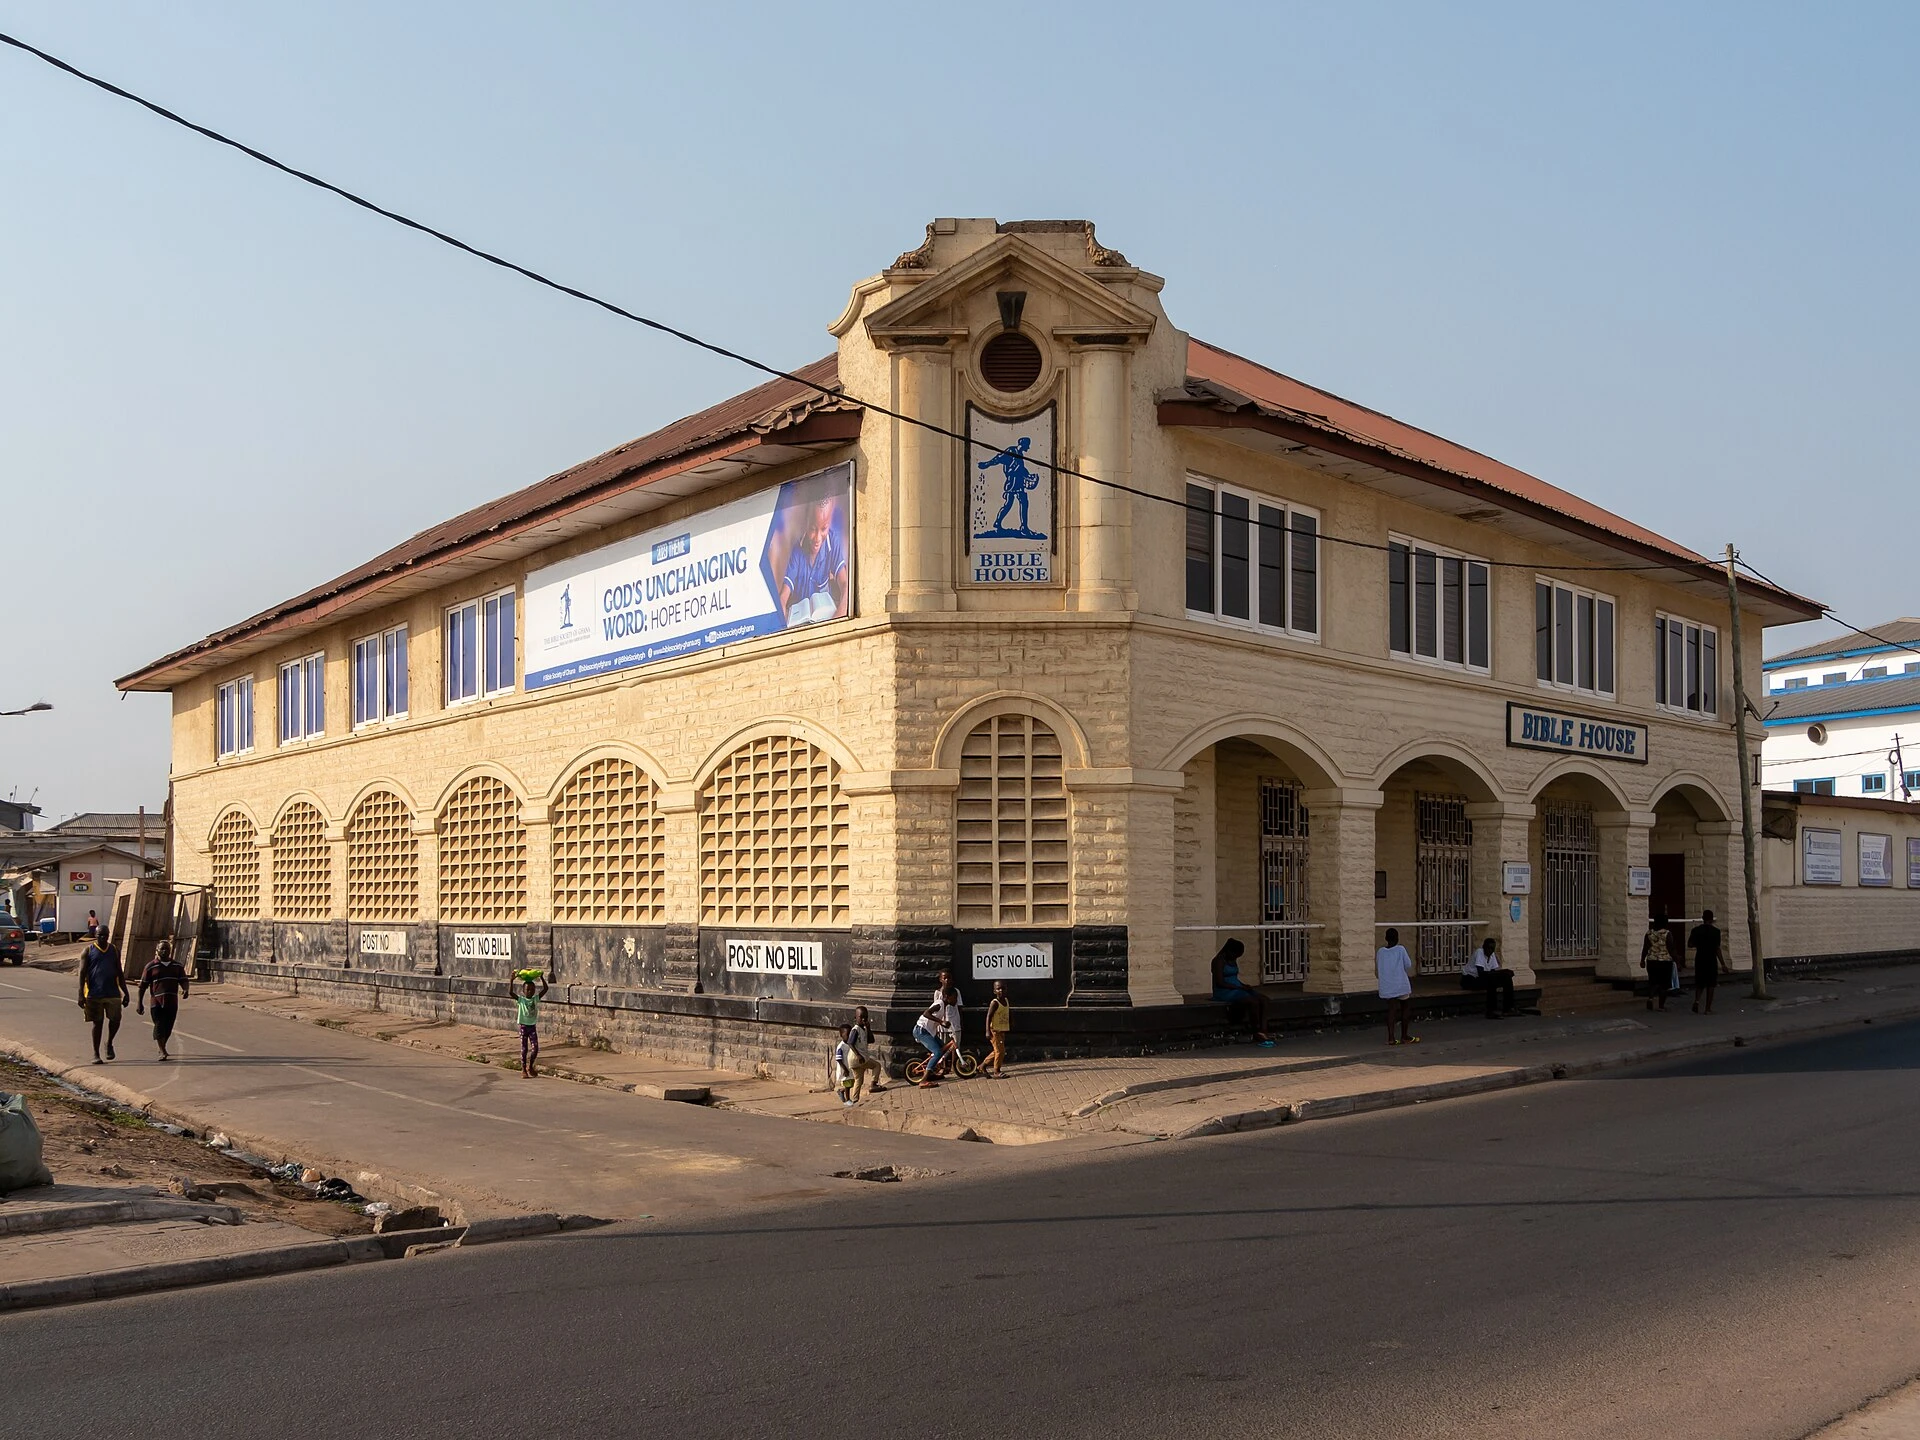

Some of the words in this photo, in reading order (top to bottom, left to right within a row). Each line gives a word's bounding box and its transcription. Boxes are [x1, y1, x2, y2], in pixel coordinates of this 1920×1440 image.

[980, 553, 1042, 567] BIBLE
[604, 580, 642, 613] GOD'S
[646, 547, 747, 601] UNCHANGING
[974, 568, 1048, 581] HOUSE
[603, 609, 648, 641] WORD:
[651, 603, 681, 630] HOPE
[684, 596, 706, 620] FOR
[710, 588, 731, 613] ALL
[1522, 712, 1574, 746] BIBLE
[1579, 722, 1636, 754] HOUSE
[362, 934, 379, 950] POST
[380, 934, 389, 951] NO
[456, 937, 475, 955] POST
[478, 938, 490, 955] NO
[491, 938, 510, 956] BILL
[729, 945, 761, 968] POST
[766, 946, 785, 970] NO
[787, 946, 818, 970] BILL
[976, 955, 1004, 968] POST
[1007, 955, 1023, 967] NO
[1025, 955, 1048, 968] BILL
